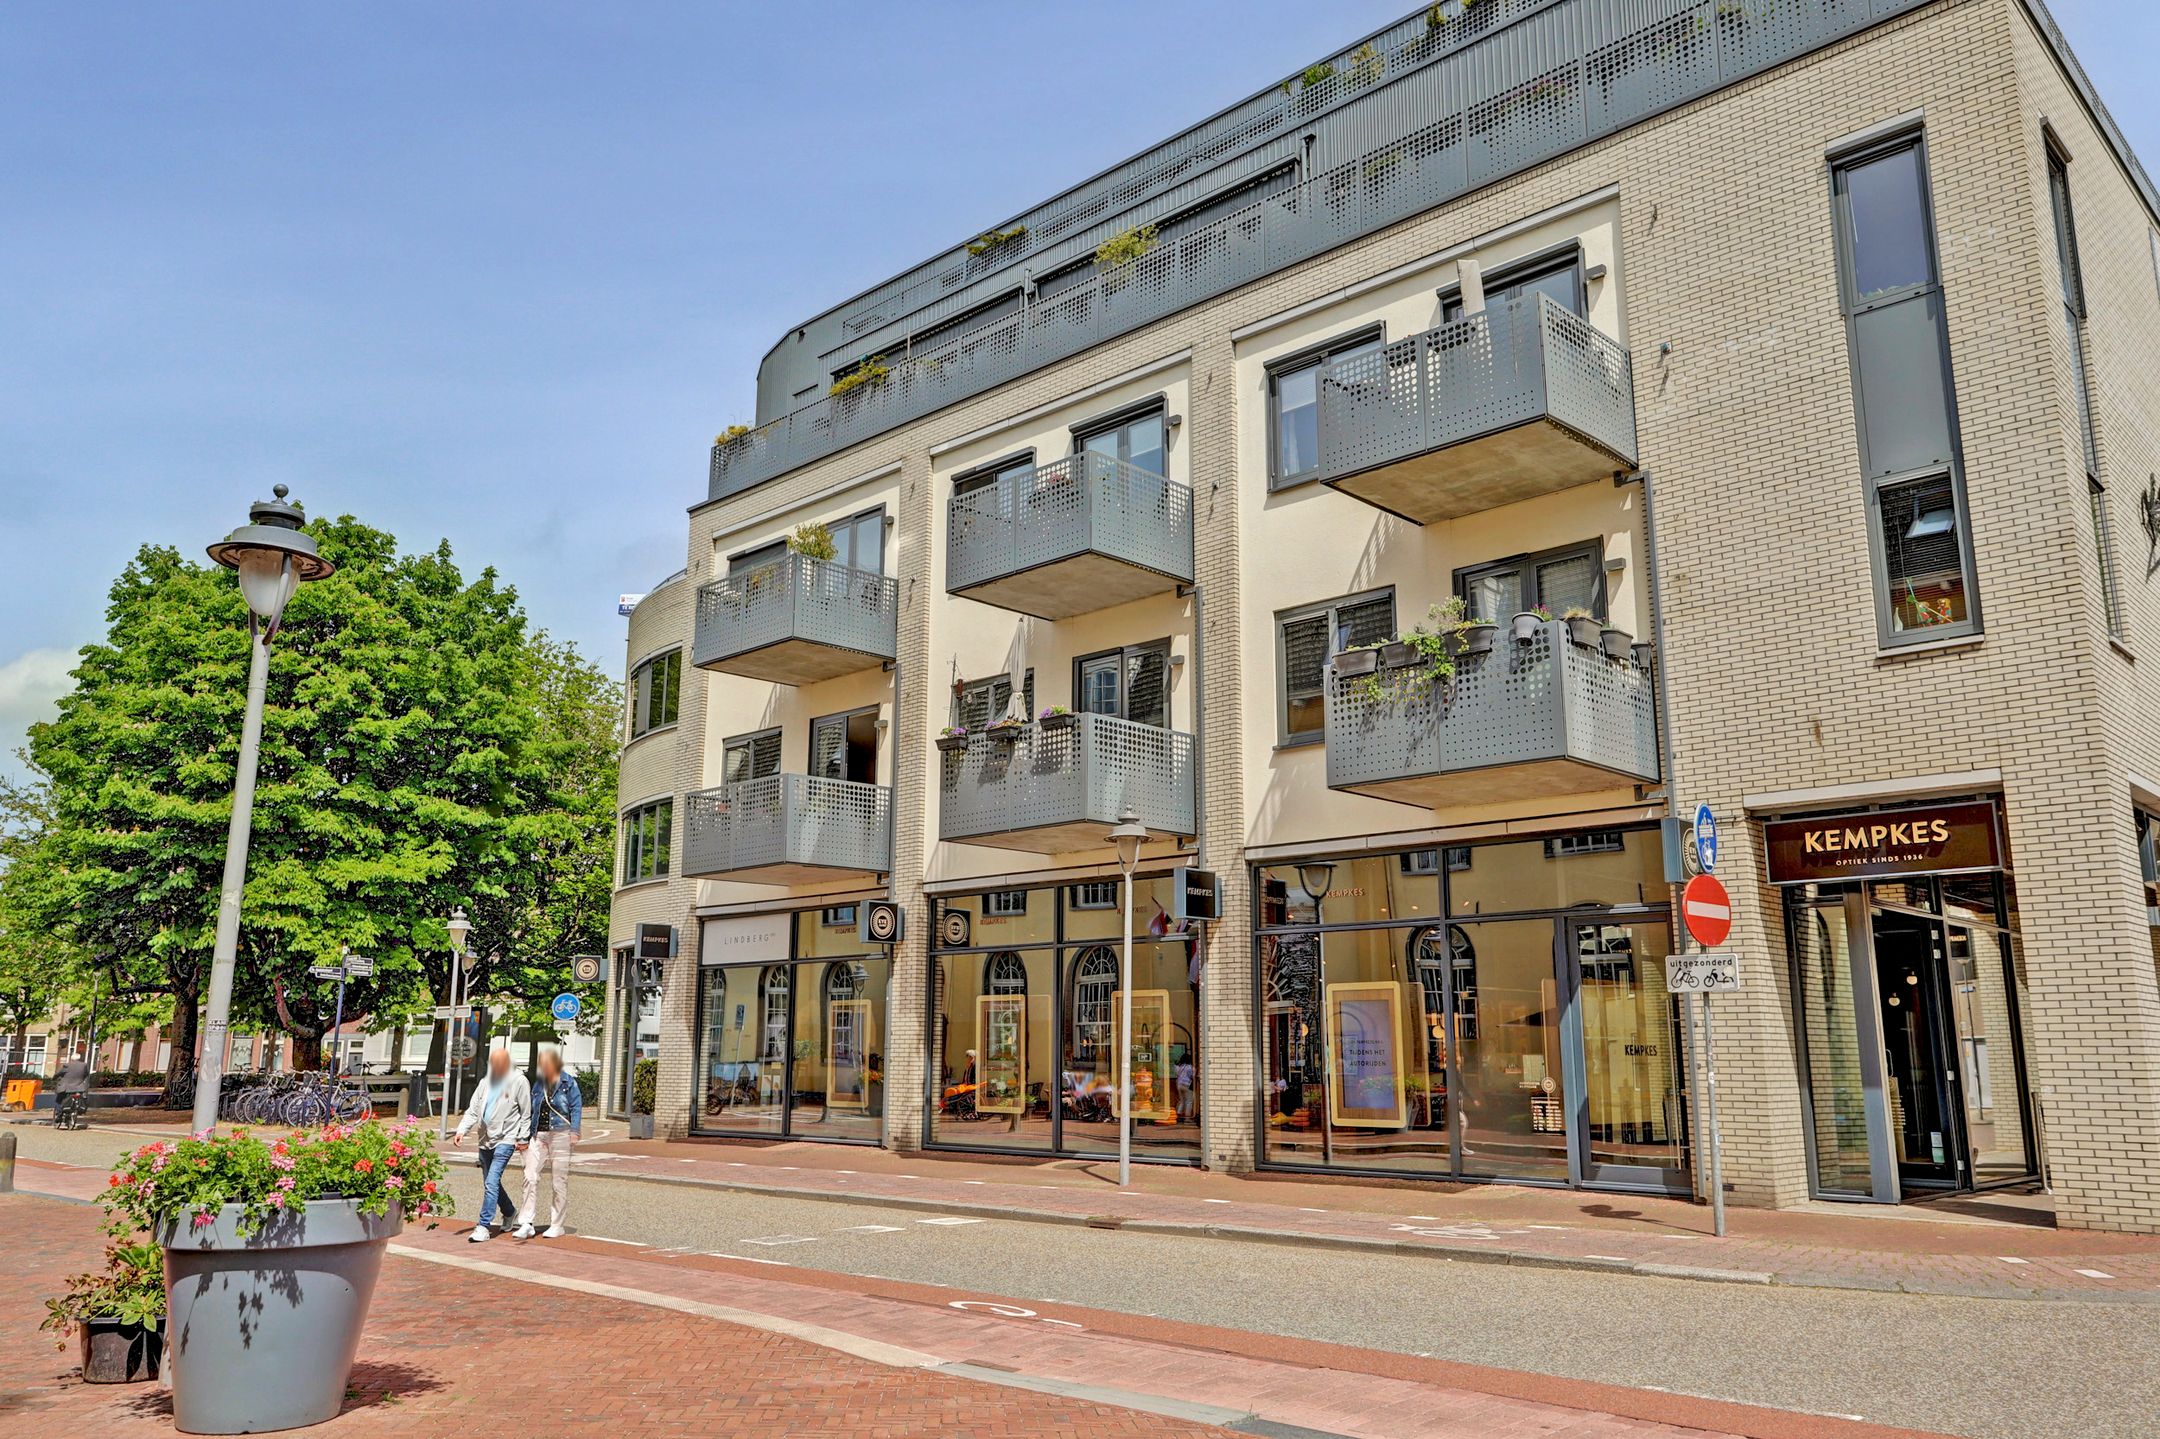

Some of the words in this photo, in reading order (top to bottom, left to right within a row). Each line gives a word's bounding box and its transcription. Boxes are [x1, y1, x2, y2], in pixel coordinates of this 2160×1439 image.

[1804, 819, 1950, 853] KEMPKES
[1835, 858, 1868, 866] OPTIEK
[1871, 855, 1899, 864] SINDS
[724, 933, 769, 945] LINDBERG
[1670, 959, 1733, 969] uitgezonderd
[1624, 1044, 1658, 1056] KEMPKES
